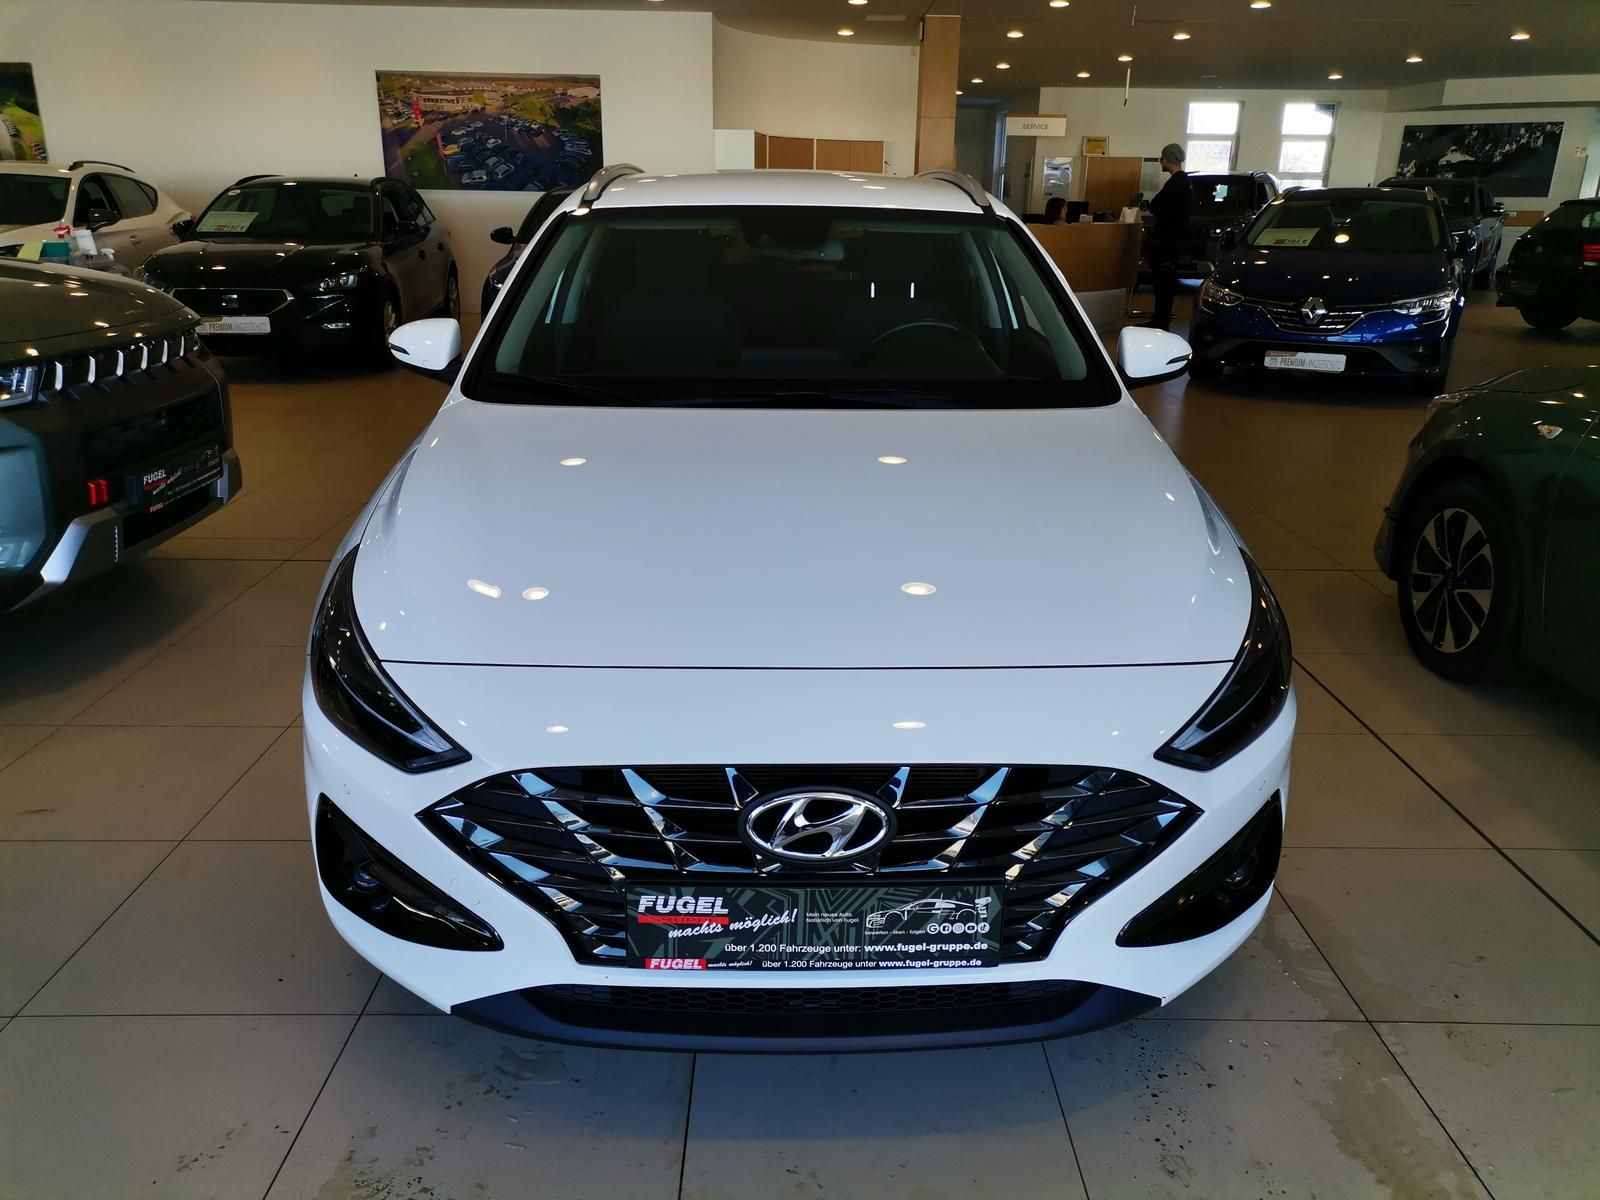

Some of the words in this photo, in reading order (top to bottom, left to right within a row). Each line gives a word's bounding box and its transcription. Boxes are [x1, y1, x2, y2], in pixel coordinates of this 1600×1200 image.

[208, 322, 232, 331] PREMIUM
[1280, 358, 1306, 368] PREMIUM
[144, 469, 167, 485] FUGEL
[638, 896, 729, 914] FUGEL
[668, 921, 723, 938] machts
[729, 908, 798, 932] möglich!
[725, 943, 747, 952] über
[750, 944, 777, 952] 1.200
[779, 944, 831, 954] Fahrzeuge
[834, 944, 861, 953] unter:
[864, 942, 988, 953] www.fugel-gruppe.de
[650, 959, 702, 969] FUGEL
[728, 960, 753, 968] möglich!
[762, 960, 781, 968] über
[784, 960, 807, 968] 1.200
[809, 960, 853, 969] Fahrzeuge
[855, 960, 877, 968] unter
[879, 959, 982, 968] www.fugel-gruppe.de
